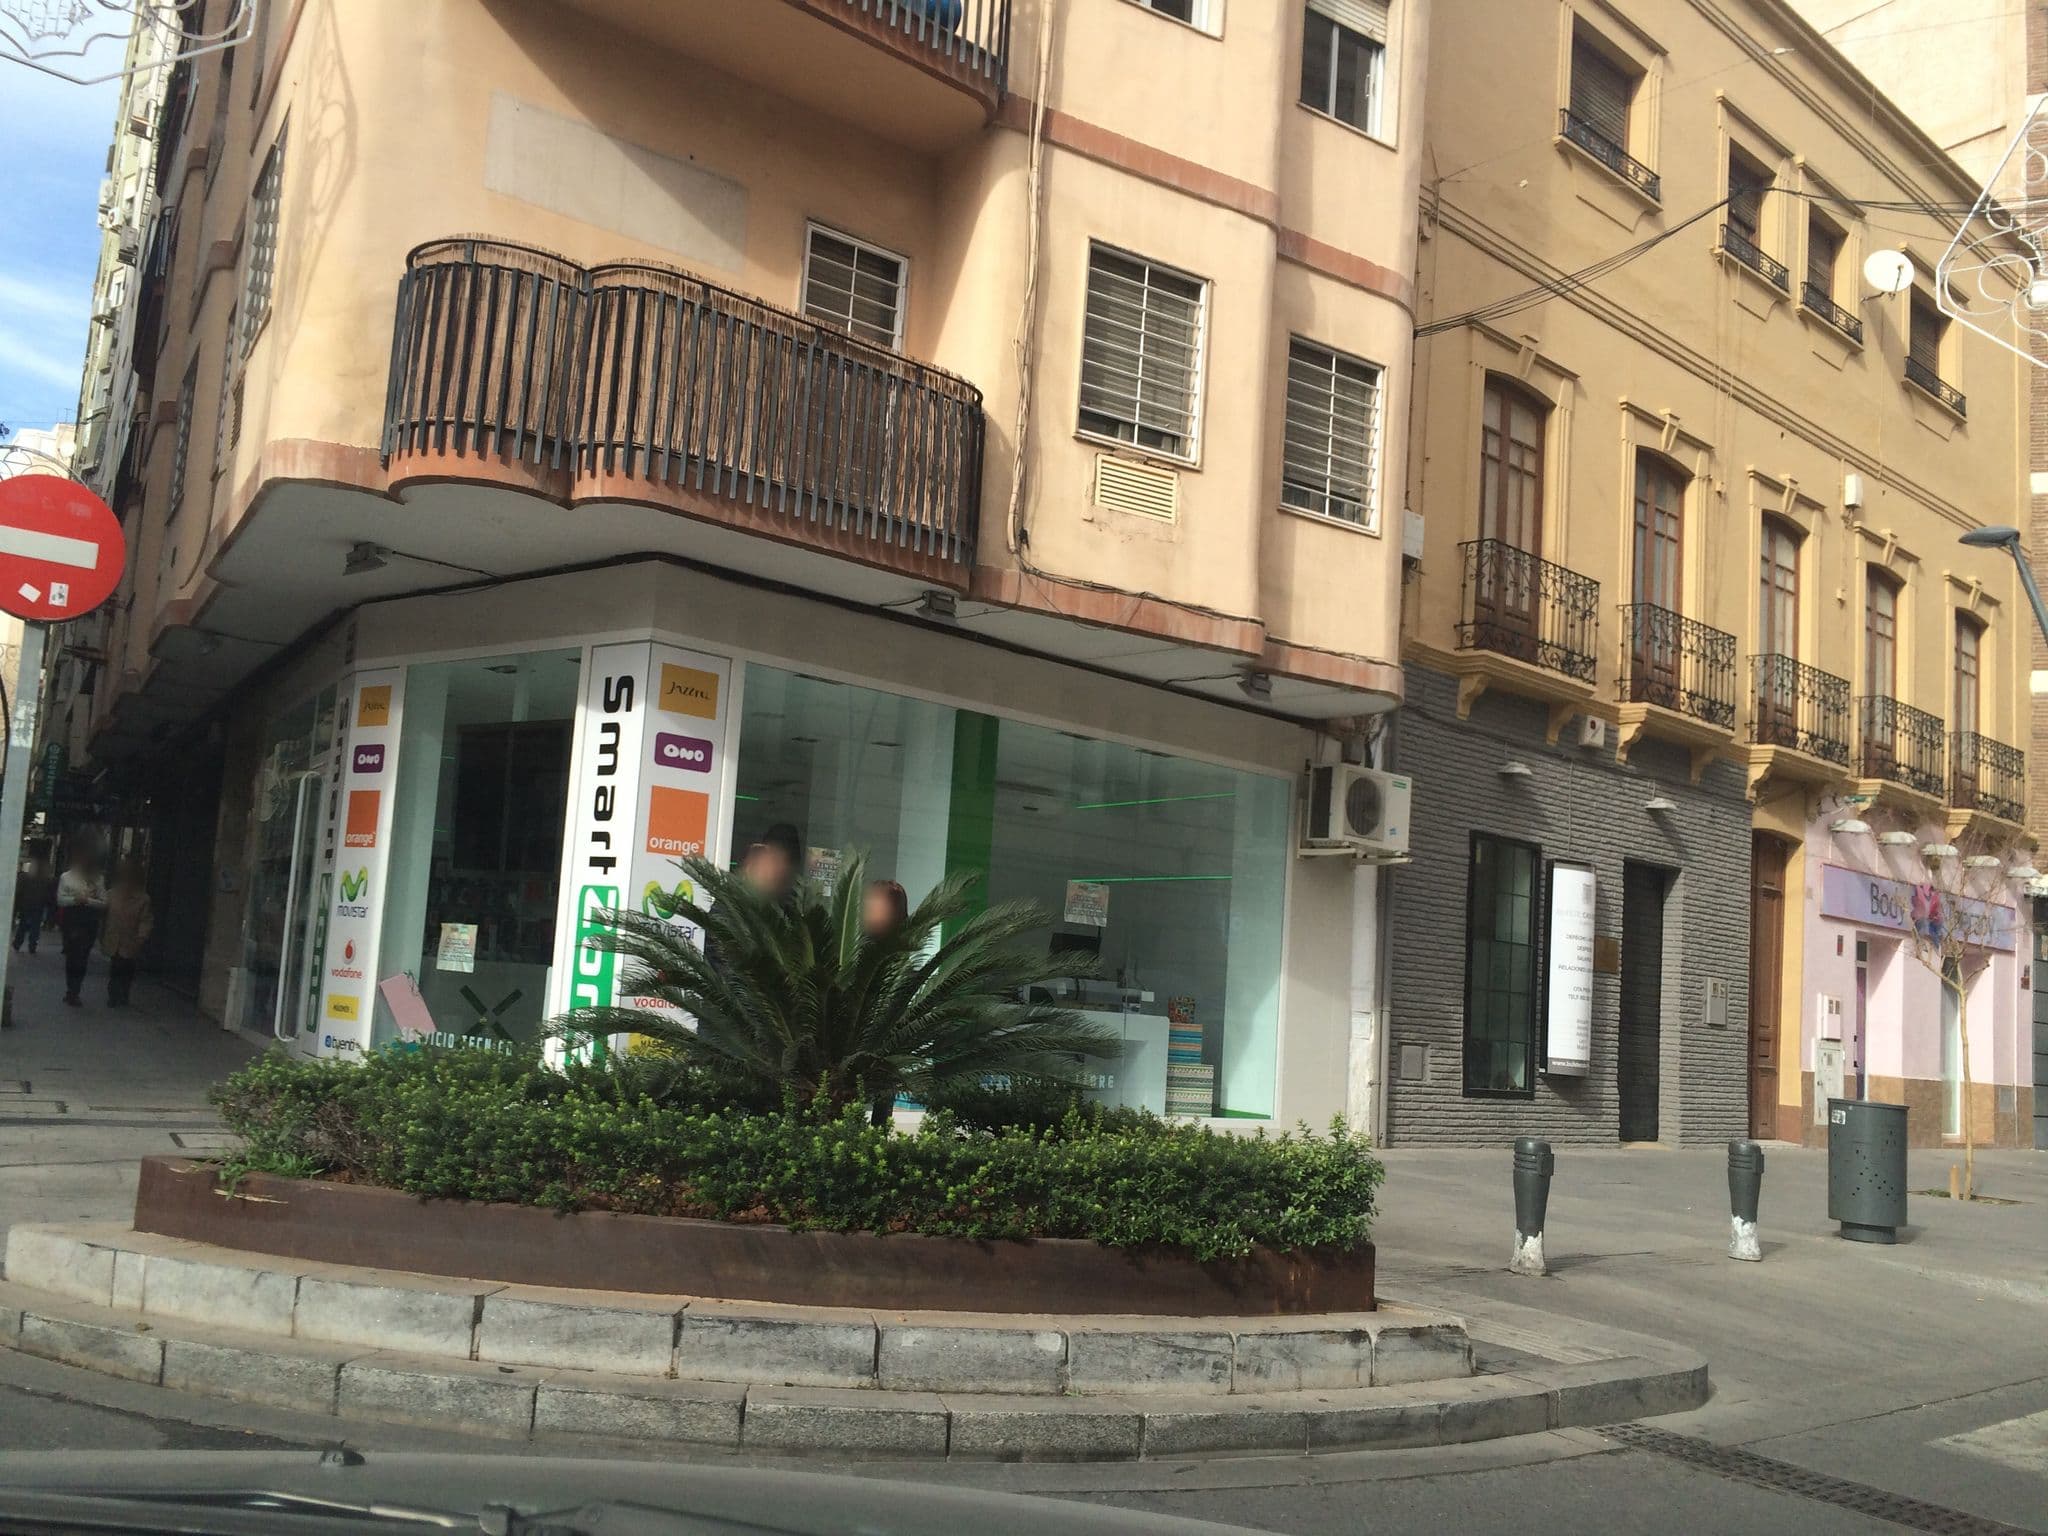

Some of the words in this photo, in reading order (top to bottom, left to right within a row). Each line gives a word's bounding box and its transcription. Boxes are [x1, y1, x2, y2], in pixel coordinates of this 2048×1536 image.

[663, 743, 705, 762] ONO
[589, 675, 634, 875] Smart
[346, 832, 374, 847] orange
[649, 836, 700, 856] orange
[336, 904, 368, 918] movistar
[331, 967, 363, 980] vodafone
